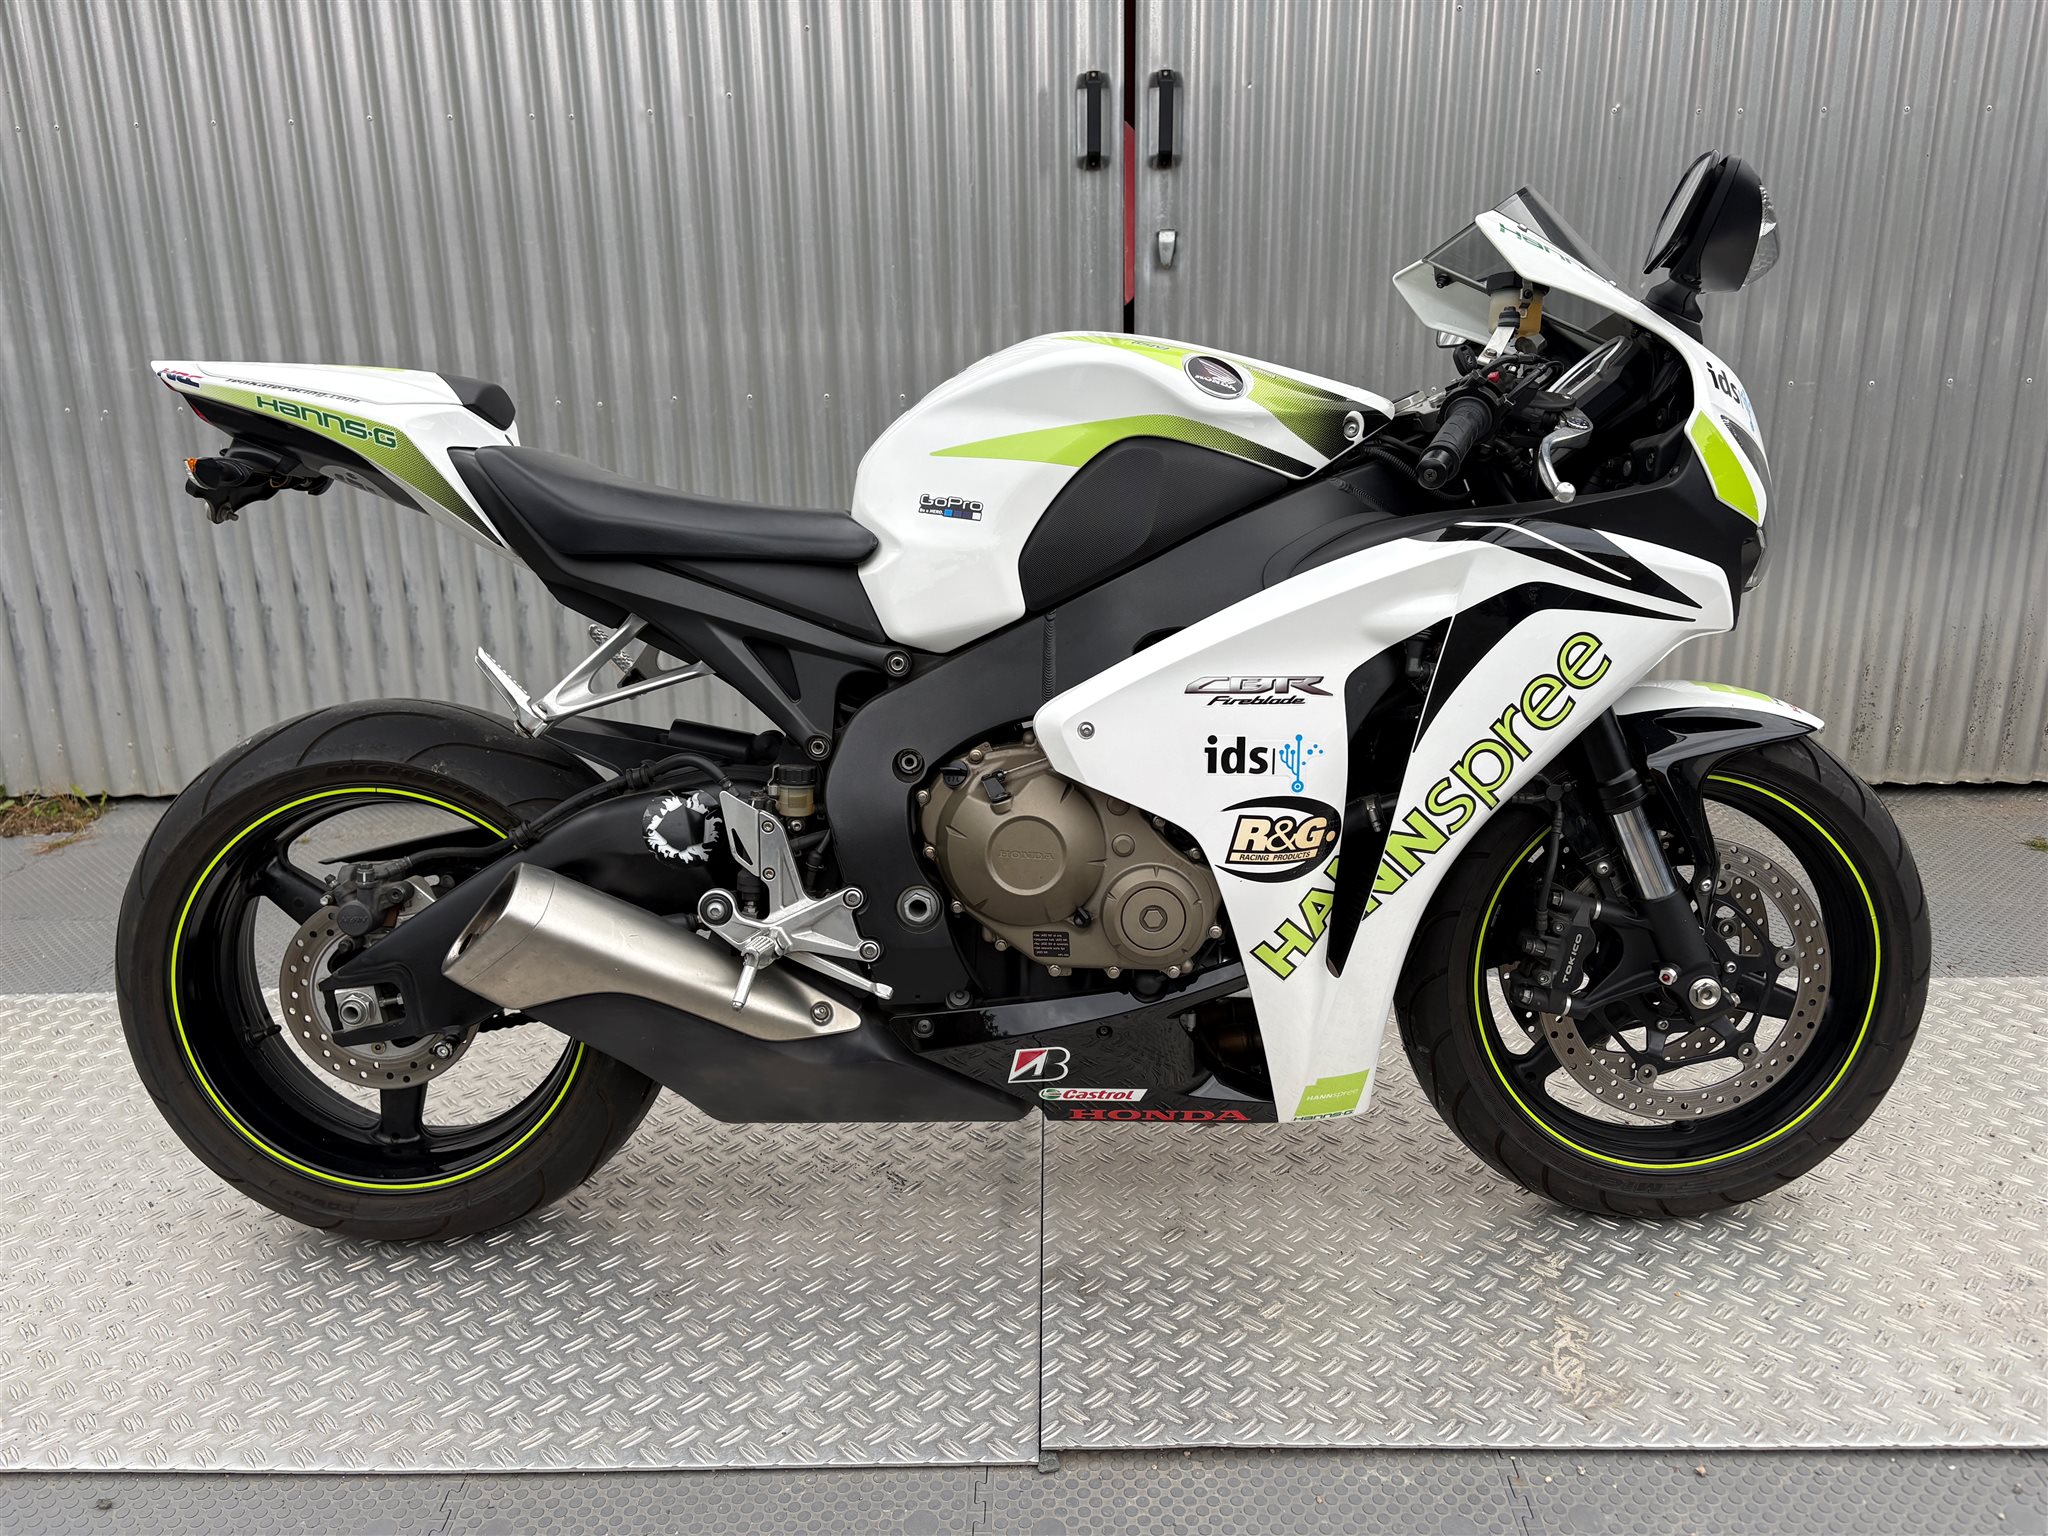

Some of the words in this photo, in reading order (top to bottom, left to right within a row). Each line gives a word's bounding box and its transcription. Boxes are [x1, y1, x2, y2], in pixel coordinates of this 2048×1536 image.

[1706, 361, 1741, 404] ids
[919, 493, 984, 512] GoPro
[1184, 676, 1334, 697] CBR
[1207, 695, 1306, 706] Fireblade
[1204, 734, 1269, 775] ids
[1239, 853, 1270, 861] RACING
[1272, 850, 1311, 861] PRODUCTS
[1562, 933, 1583, 984] TOKICO
[1062, 1089, 1136, 1100] Castrol
[1069, 1108, 1252, 1121] HONDA
